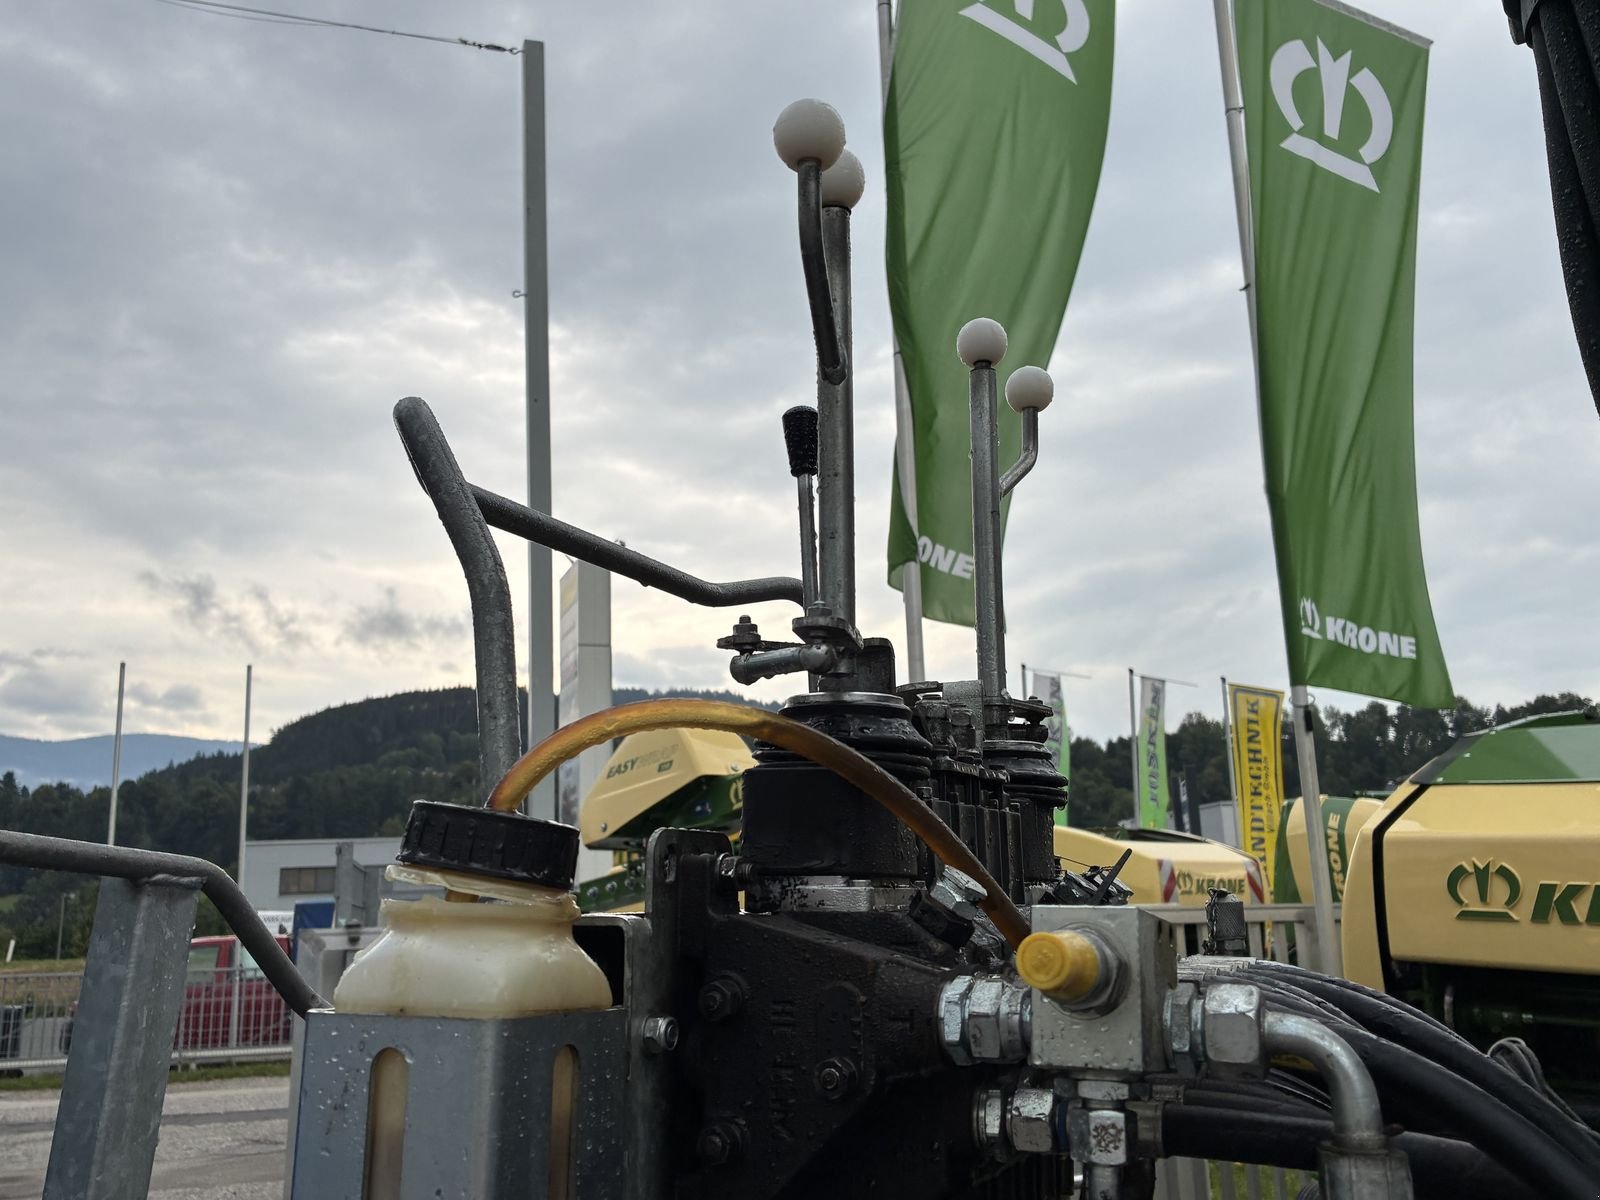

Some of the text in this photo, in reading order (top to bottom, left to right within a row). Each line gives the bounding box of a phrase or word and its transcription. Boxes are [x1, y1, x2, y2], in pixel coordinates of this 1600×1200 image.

[918, 535, 976, 580] ONE
[1326, 616, 1416, 660] KRONE
[1246, 699, 1268, 868] NDTECHNIK
[1530, 881, 1600, 926] K
